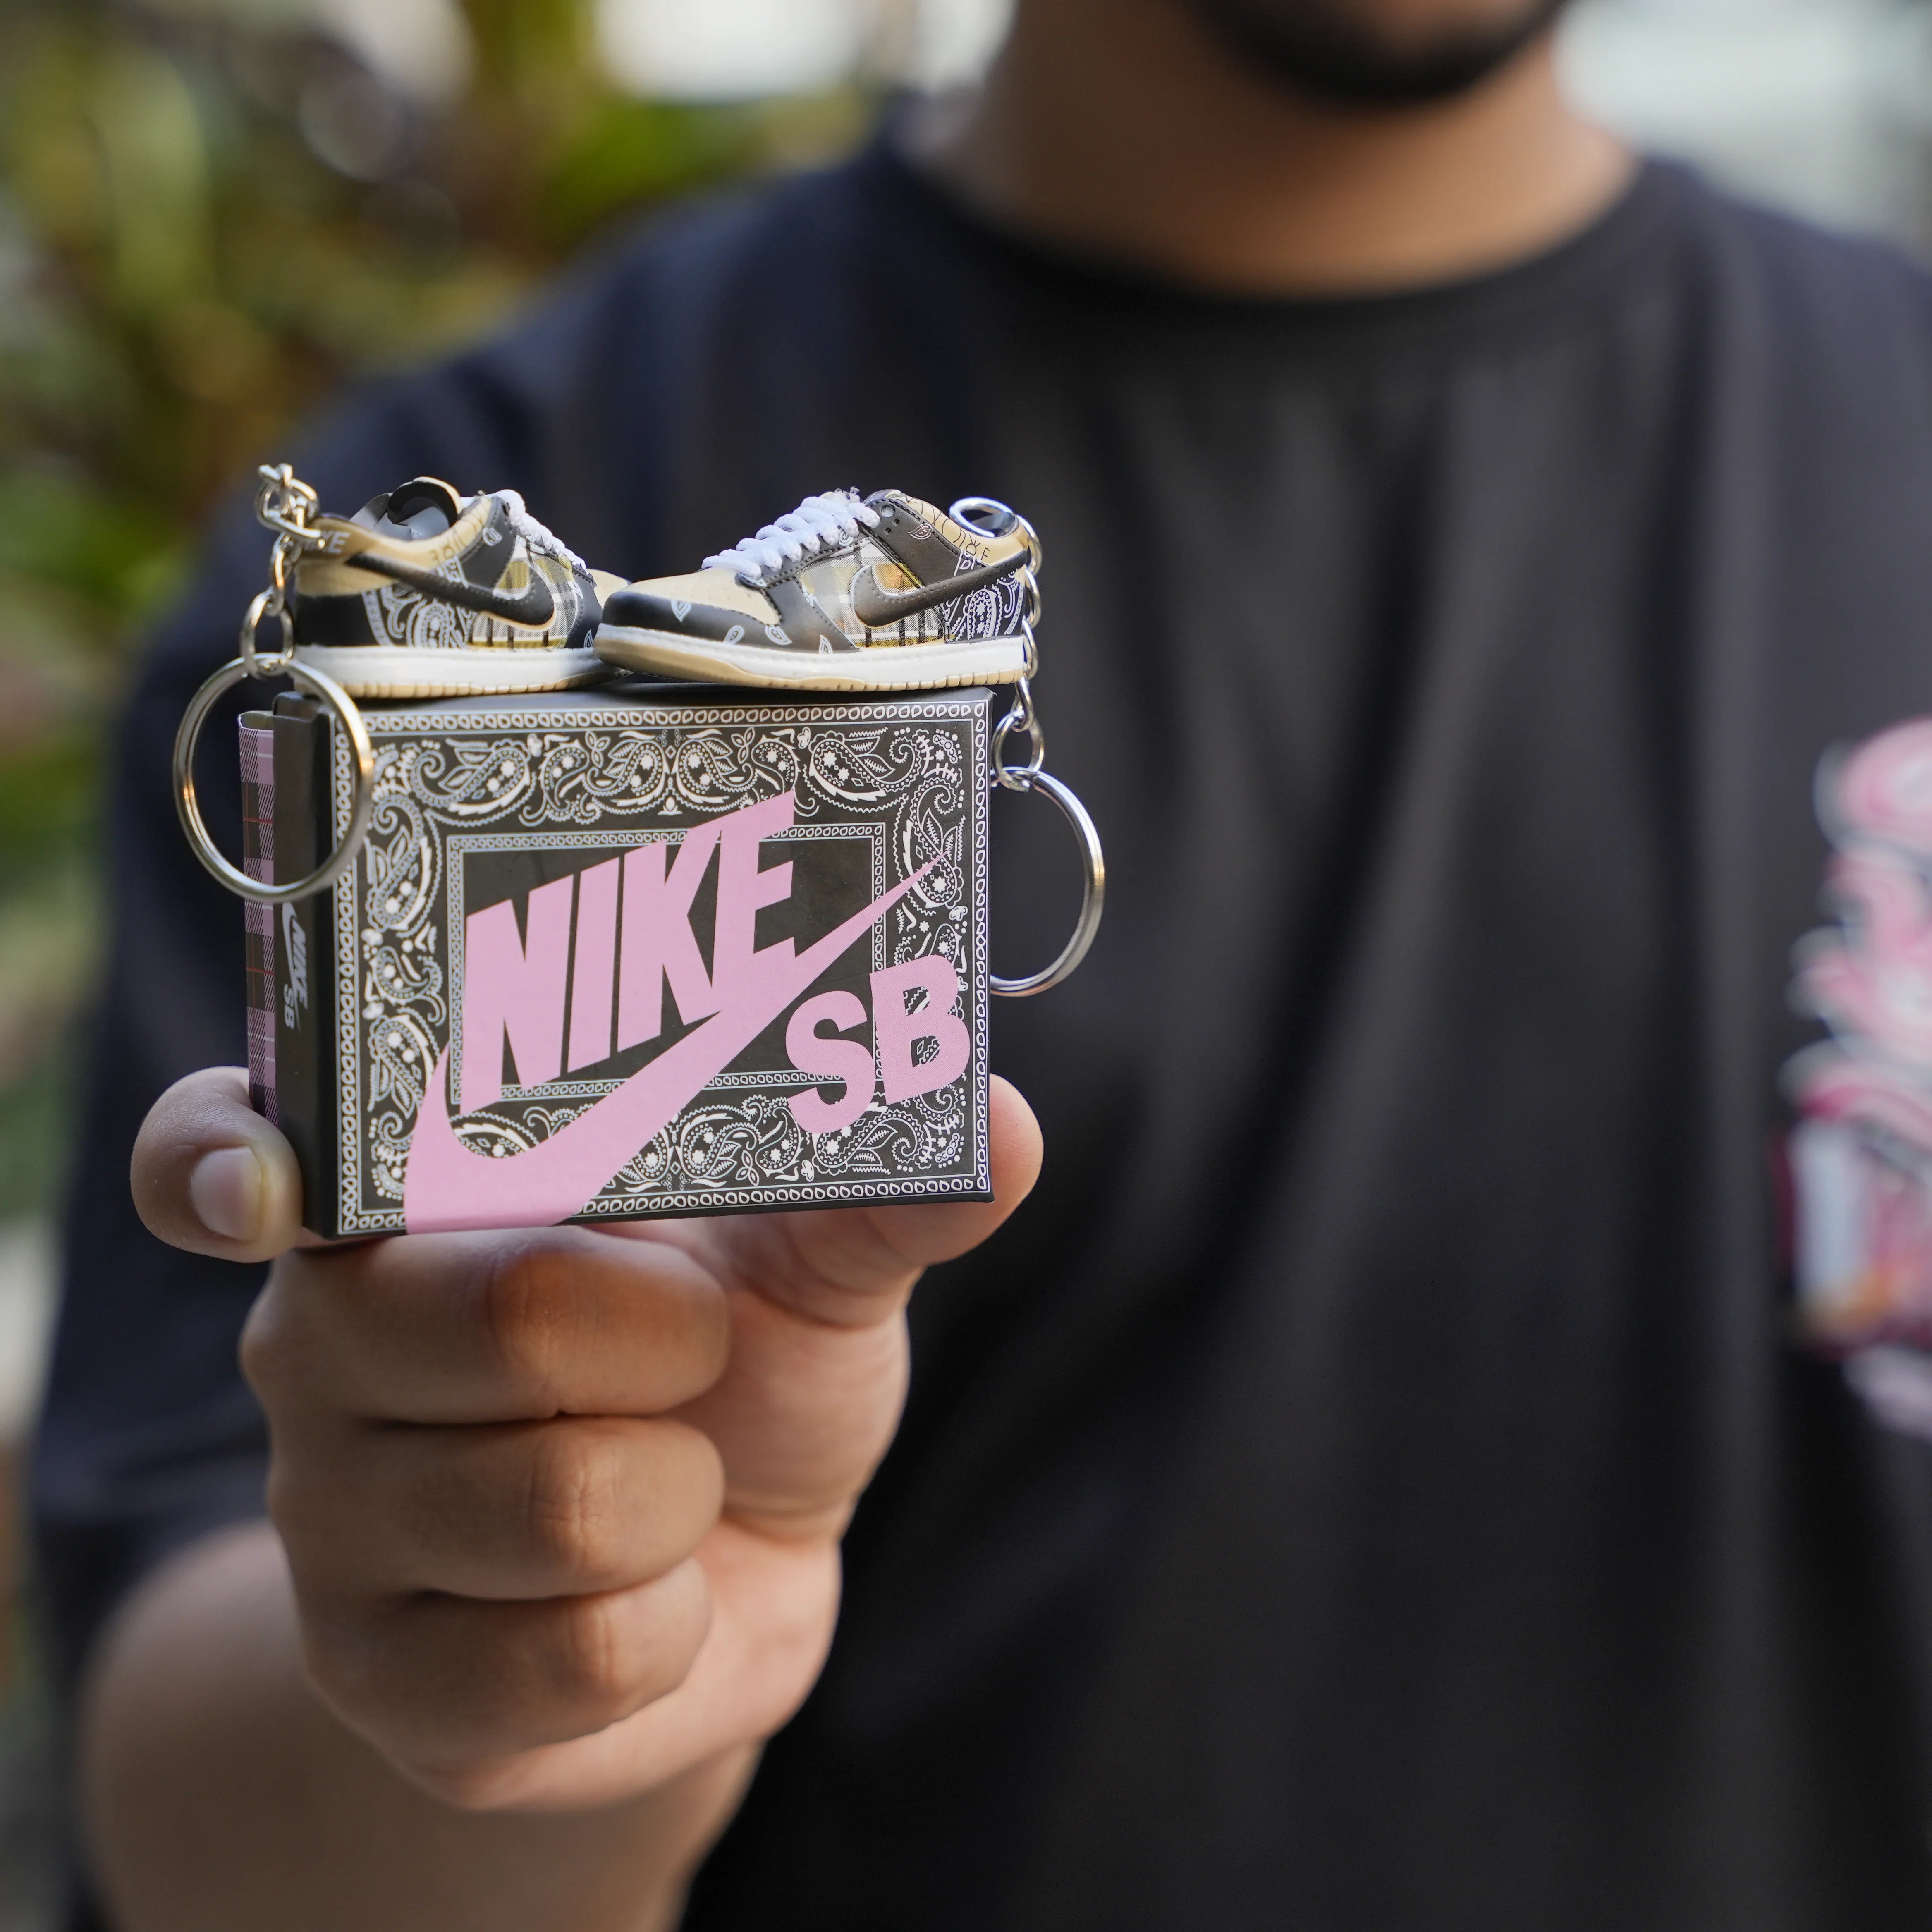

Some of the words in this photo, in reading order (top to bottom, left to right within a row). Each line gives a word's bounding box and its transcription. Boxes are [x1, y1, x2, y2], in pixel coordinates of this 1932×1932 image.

[284, 983, 295, 1029] SB
[292, 917, 308, 1009] NIKE
[459, 788, 795, 1115] NIKE
[786, 954, 970, 1134] SB
